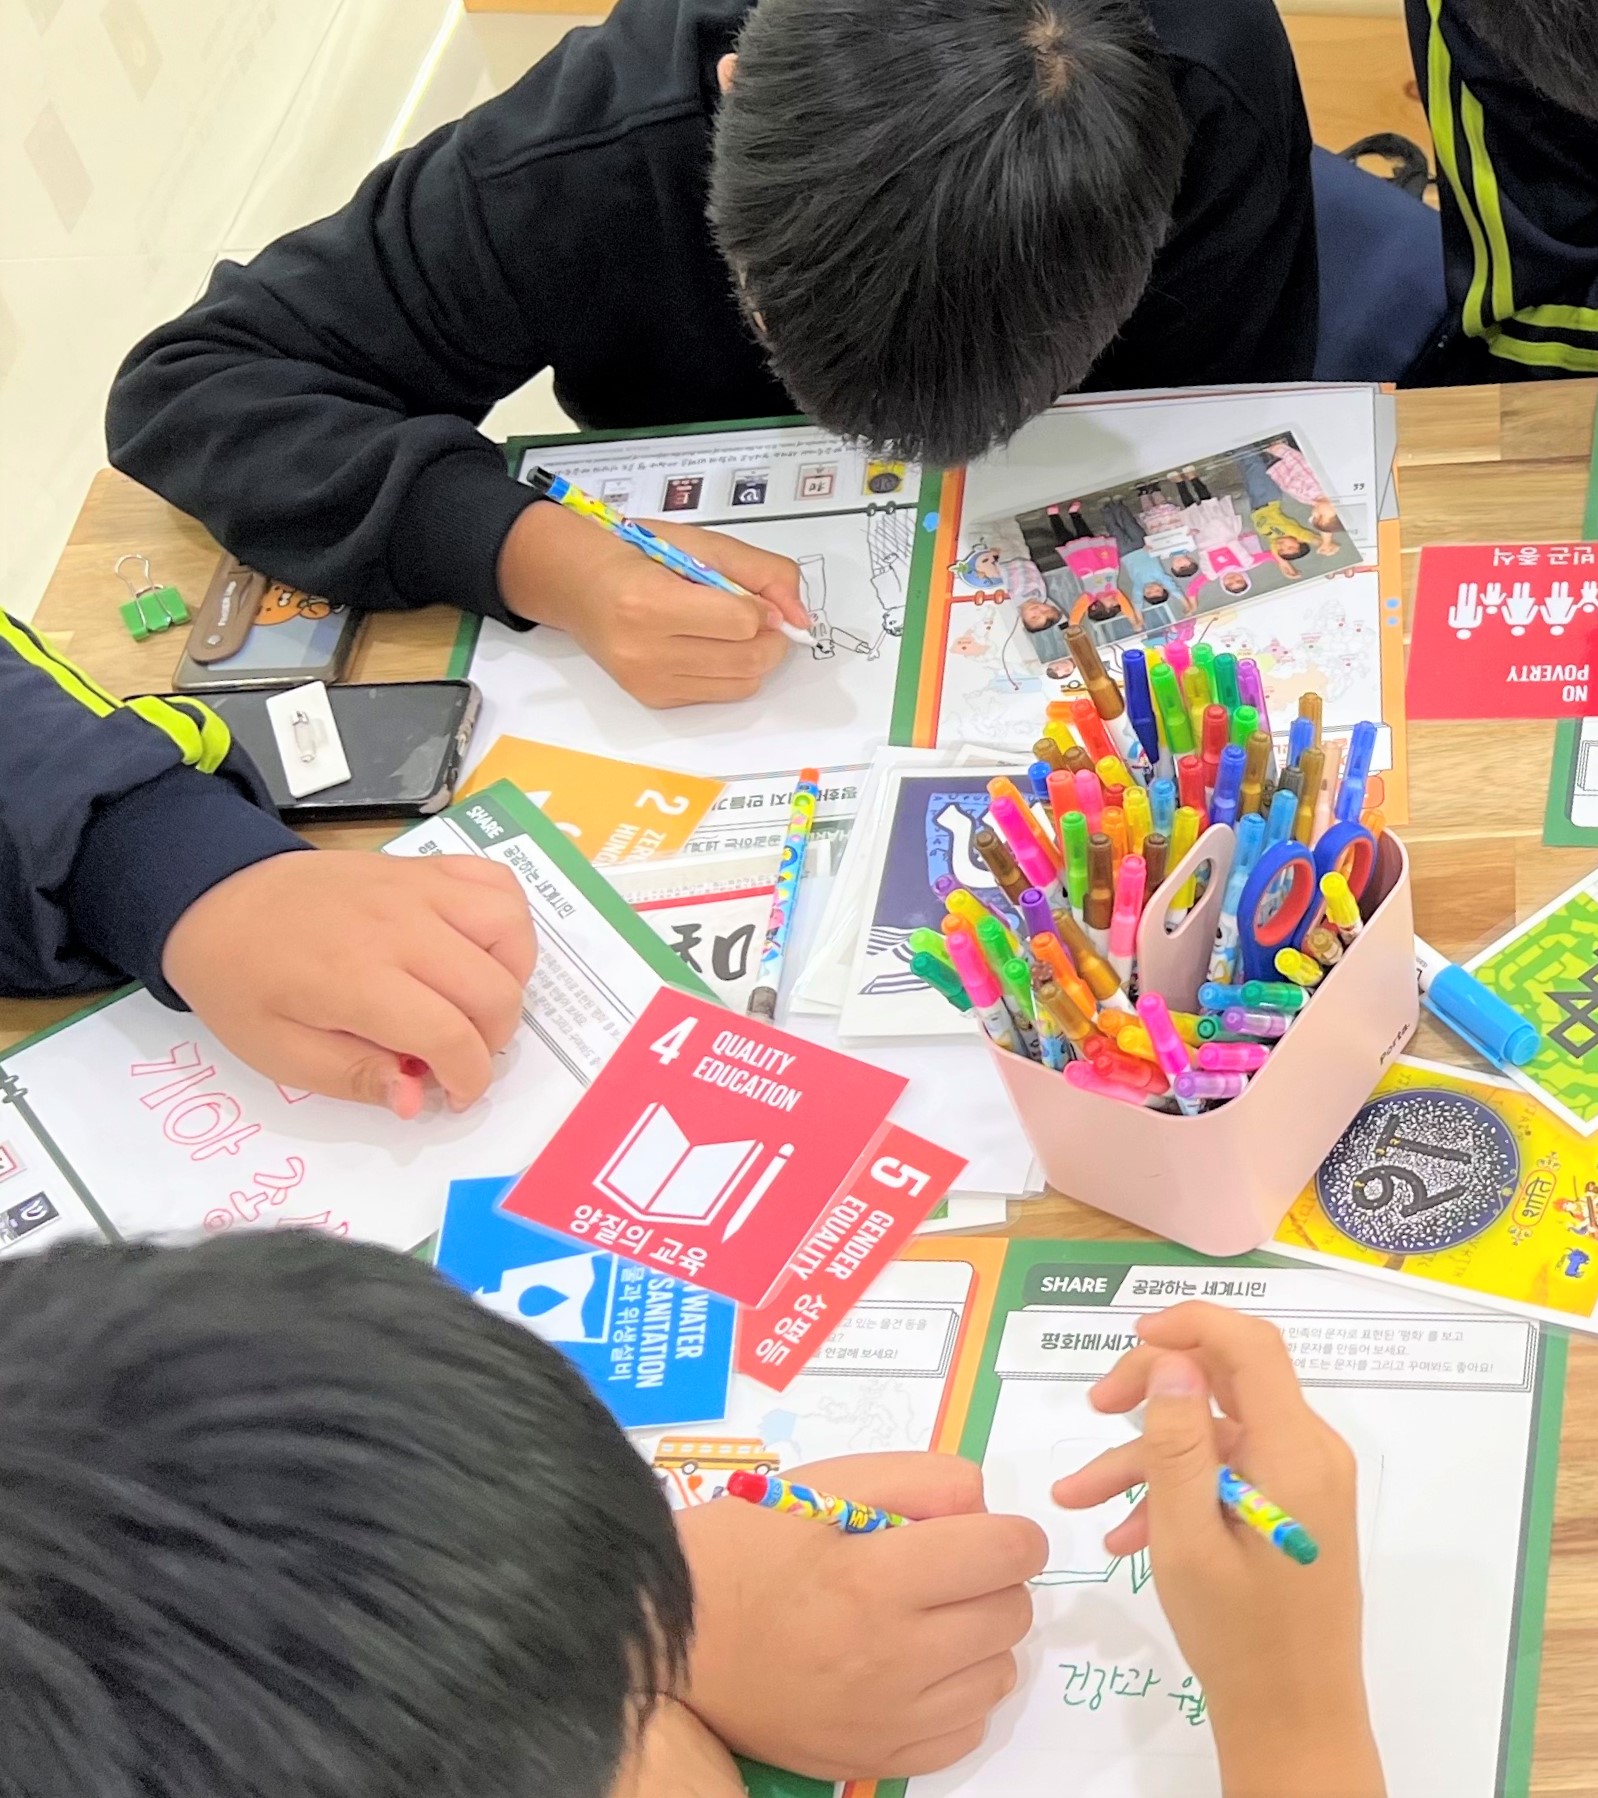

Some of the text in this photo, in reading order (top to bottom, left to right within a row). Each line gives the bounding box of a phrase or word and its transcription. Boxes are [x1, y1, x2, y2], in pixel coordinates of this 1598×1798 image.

[1492, 546, 1596, 567] 빈곤 종식
[1505, 663, 1590, 683] POVERTY
[1561, 684, 1588, 702] NO
[465, 805, 505, 839] SHARE
[634, 789, 690, 816] 2
[724, 834, 782, 848] 공감하는
[503, 844, 577, 919] 공감하는 세계시민
[648, 1015, 700, 1066] 4
[710, 1029, 798, 1077] QUALITY
[692, 1055, 803, 1113] EDUCATION
[869, 1155, 932, 1198] 5
[570, 1204, 710, 1278] 양질의 교육
[787, 1194, 868, 1282] EQUALITY
[824, 1208, 896, 1281] GENDER
[1040, 1276, 1108, 1294] SHARE
[1132, 1280, 1267, 1298] 공감하는 세계시민
[608, 1266, 646, 1381] 물과 위생설비
[635, 1276, 676, 1389] SANITATION
[674, 1293, 710, 1360] WATER
[755, 1293, 828, 1367] 성평등
[1058, 1660, 1162, 1711] 건강과
